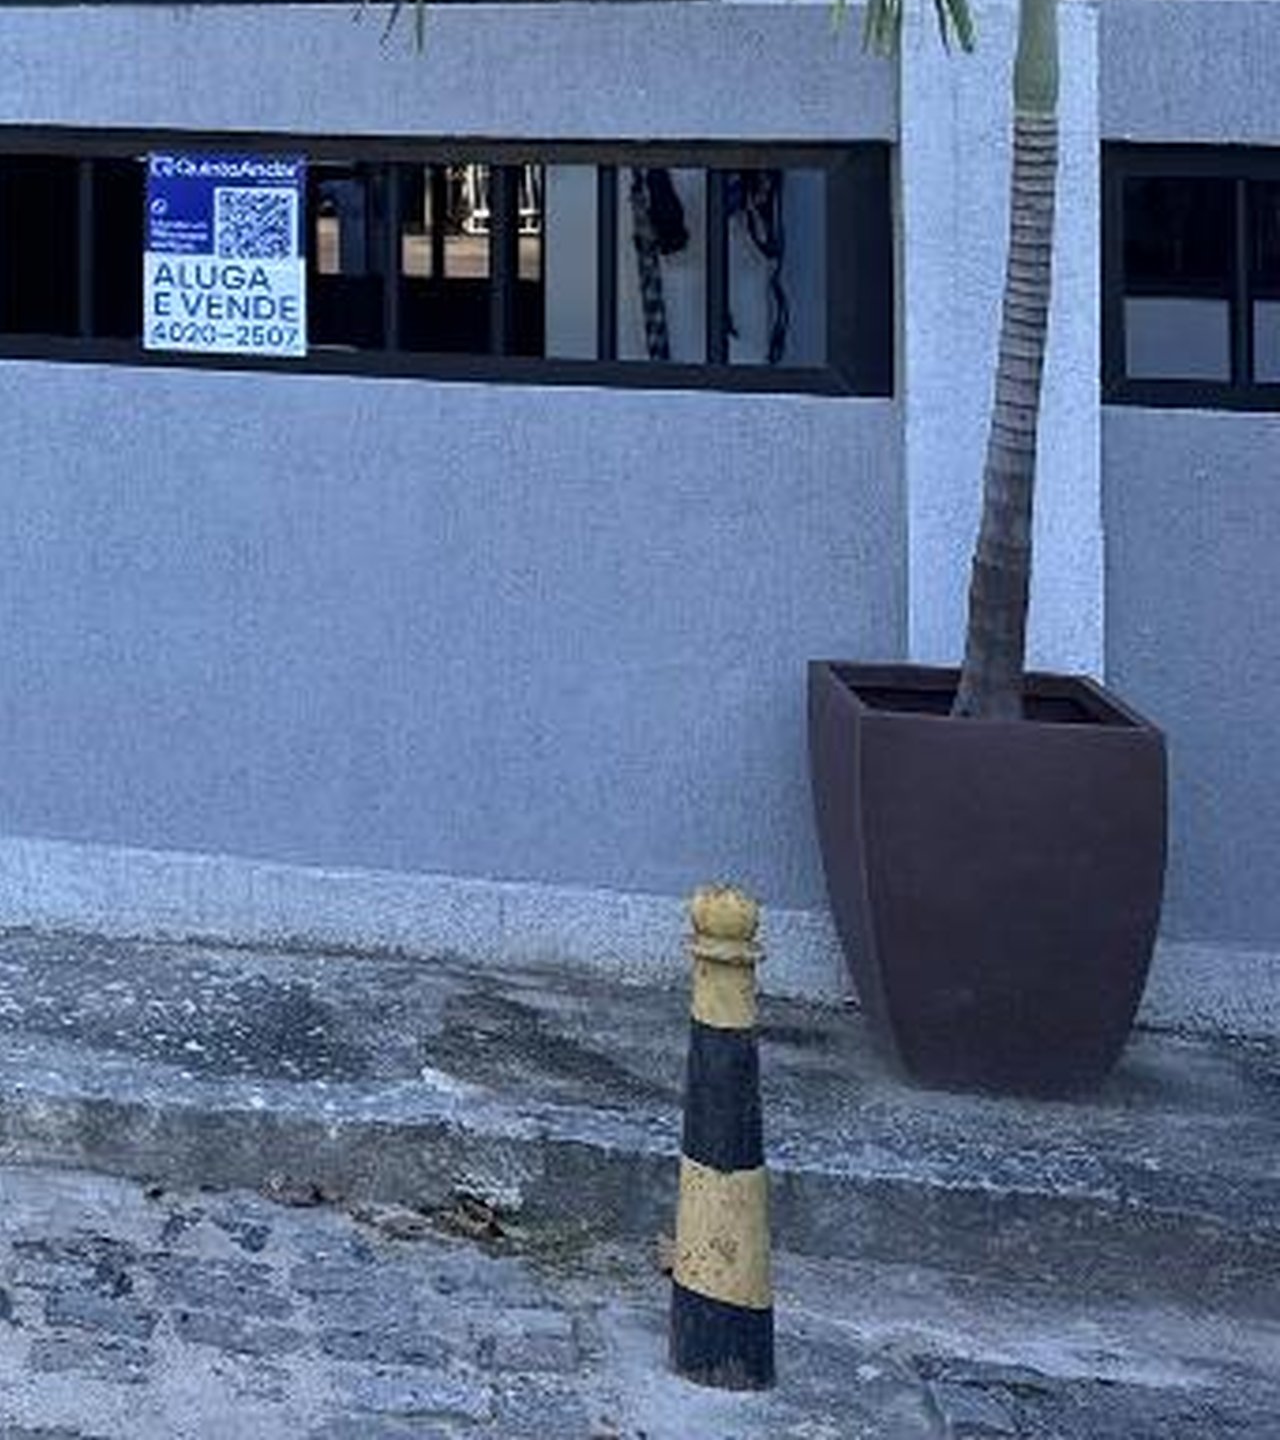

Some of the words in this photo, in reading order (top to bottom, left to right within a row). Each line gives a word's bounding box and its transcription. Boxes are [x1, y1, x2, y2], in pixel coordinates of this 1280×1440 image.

[153, 261, 271, 291] ALUGA
[154, 292, 172, 317] E
[180, 292, 299, 323] VENDE
[151, 322, 299, 347] 4020-2507
